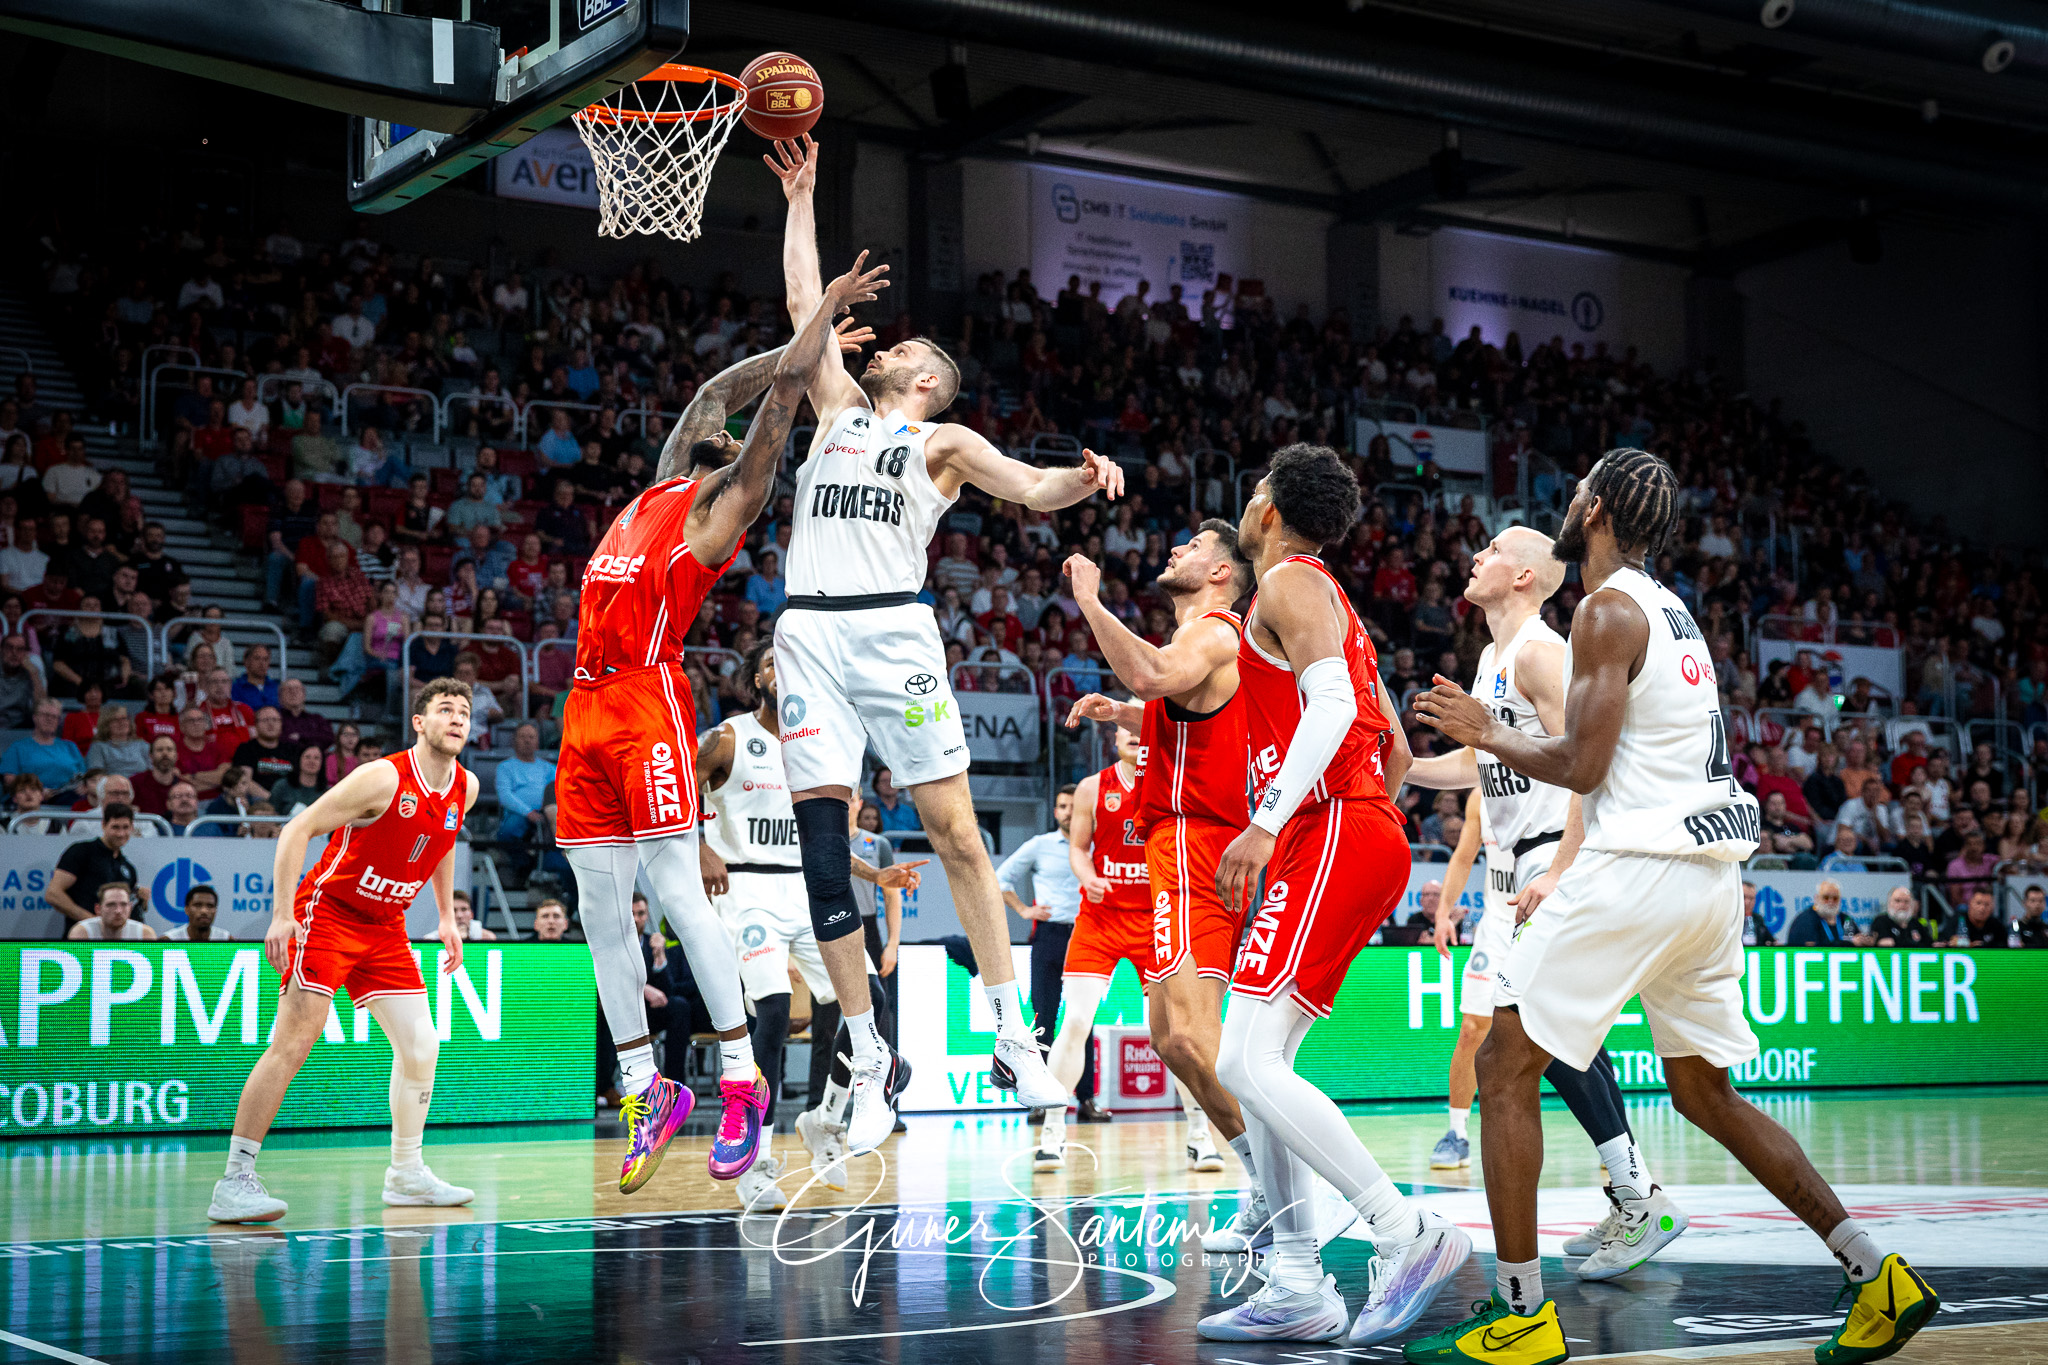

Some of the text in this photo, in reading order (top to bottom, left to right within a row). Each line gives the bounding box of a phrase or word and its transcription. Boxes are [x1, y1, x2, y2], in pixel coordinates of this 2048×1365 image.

[756, 64, 816, 83] SPALDING
[770, 100, 791, 108] BBL
[836, 445, 866, 455] VEOLIA
[875, 444, 911, 479] 18
[812, 484, 905, 526] TOWERS
[905, 700, 951, 727] S+K
[408, 833, 431, 862] 11
[356, 887, 382, 901] Technik
[1124, 1062, 1162, 1073] SPRUDEL
[1628, 1146, 1637, 1168] CRAFT
